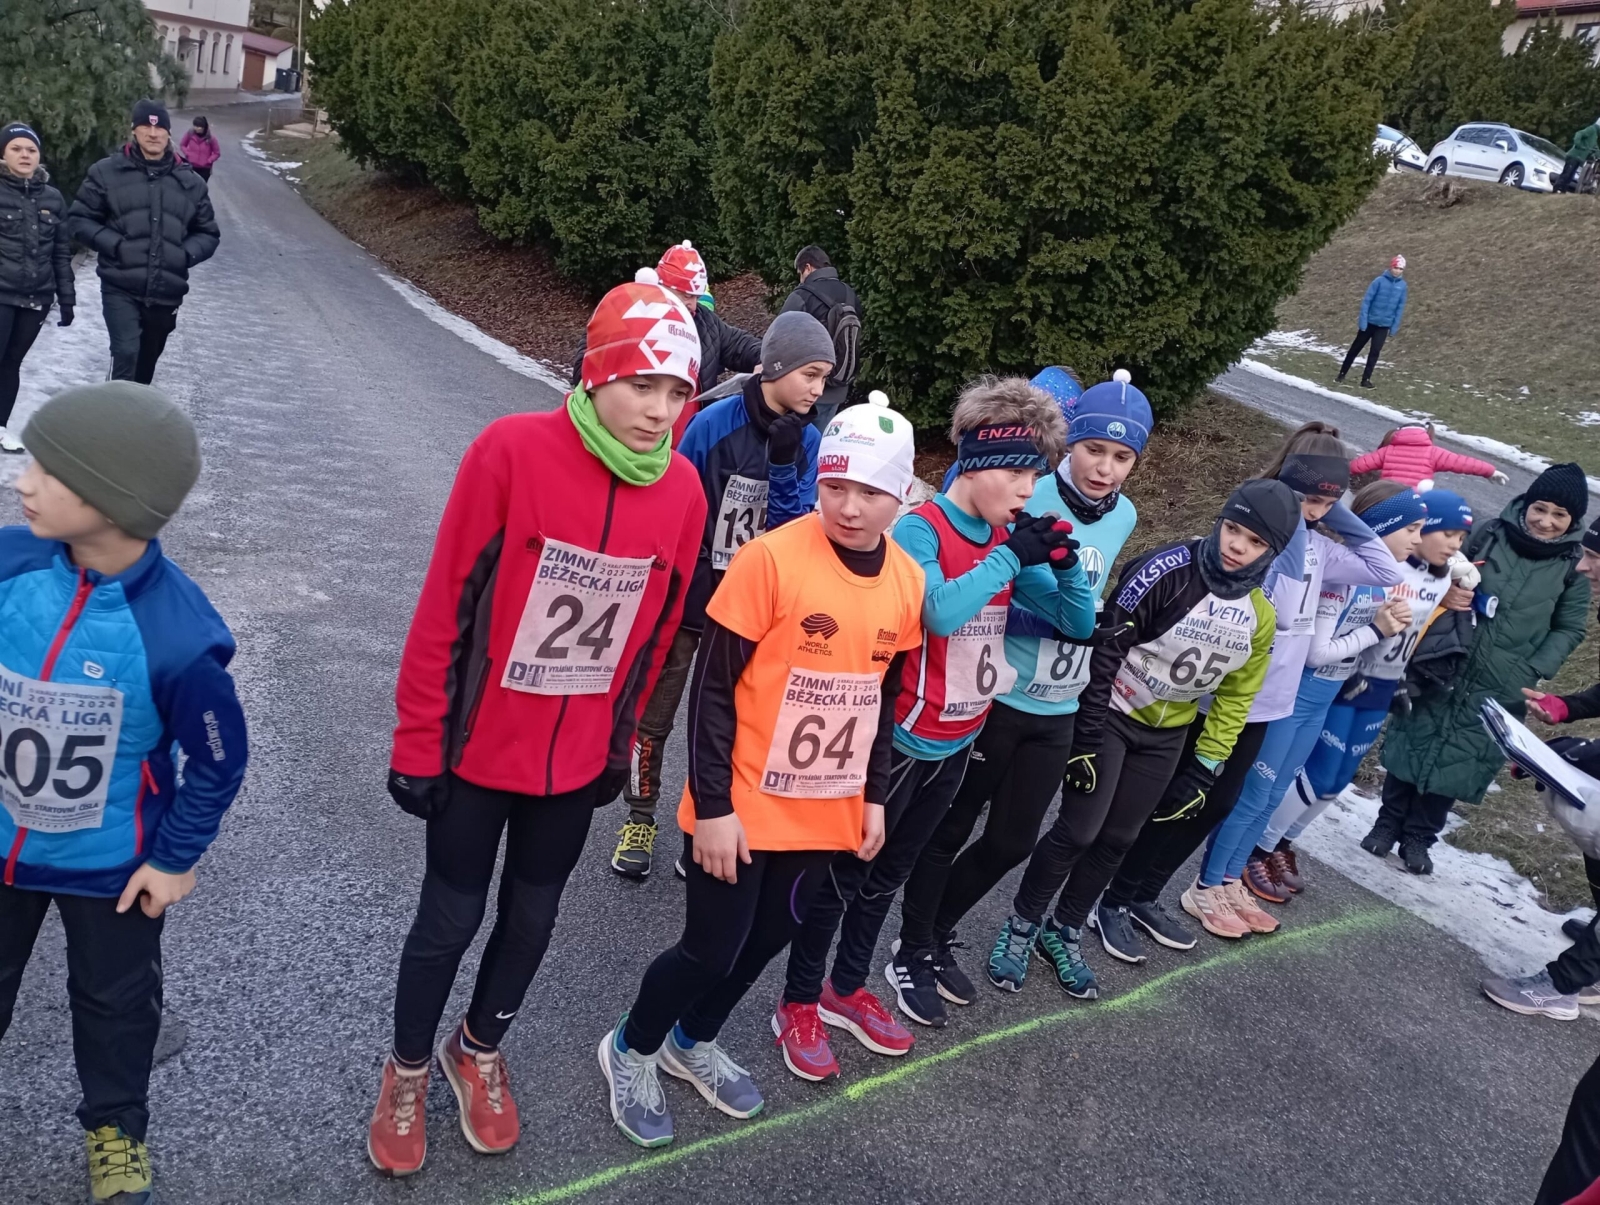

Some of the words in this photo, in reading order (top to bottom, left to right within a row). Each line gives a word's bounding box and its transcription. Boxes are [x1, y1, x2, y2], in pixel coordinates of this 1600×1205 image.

[959, 454, 1039, 473] YNAFIT
[729, 480, 758, 493] ZIMNÍ
[544, 547, 599, 572] ZIMNÍ
[538, 564, 612, 592] BĚŽECKÁ
[616, 579, 645, 592] LIGA
[535, 594, 621, 660] 24
[1175, 626, 1222, 645] BĚŽECKÁ
[1225, 640, 1249, 652] LIGA
[804, 640, 829, 649] WORLD
[976, 644, 997, 696] 6
[1170, 646, 1231, 688] 65
[790, 674, 835, 691] ZIMNÍ
[786, 689, 847, 706] BĚŽECKÁ
[852, 694, 878, 706] LIGA
[61, 710, 112, 725] LIGA
[788, 714, 858, 770] 64
